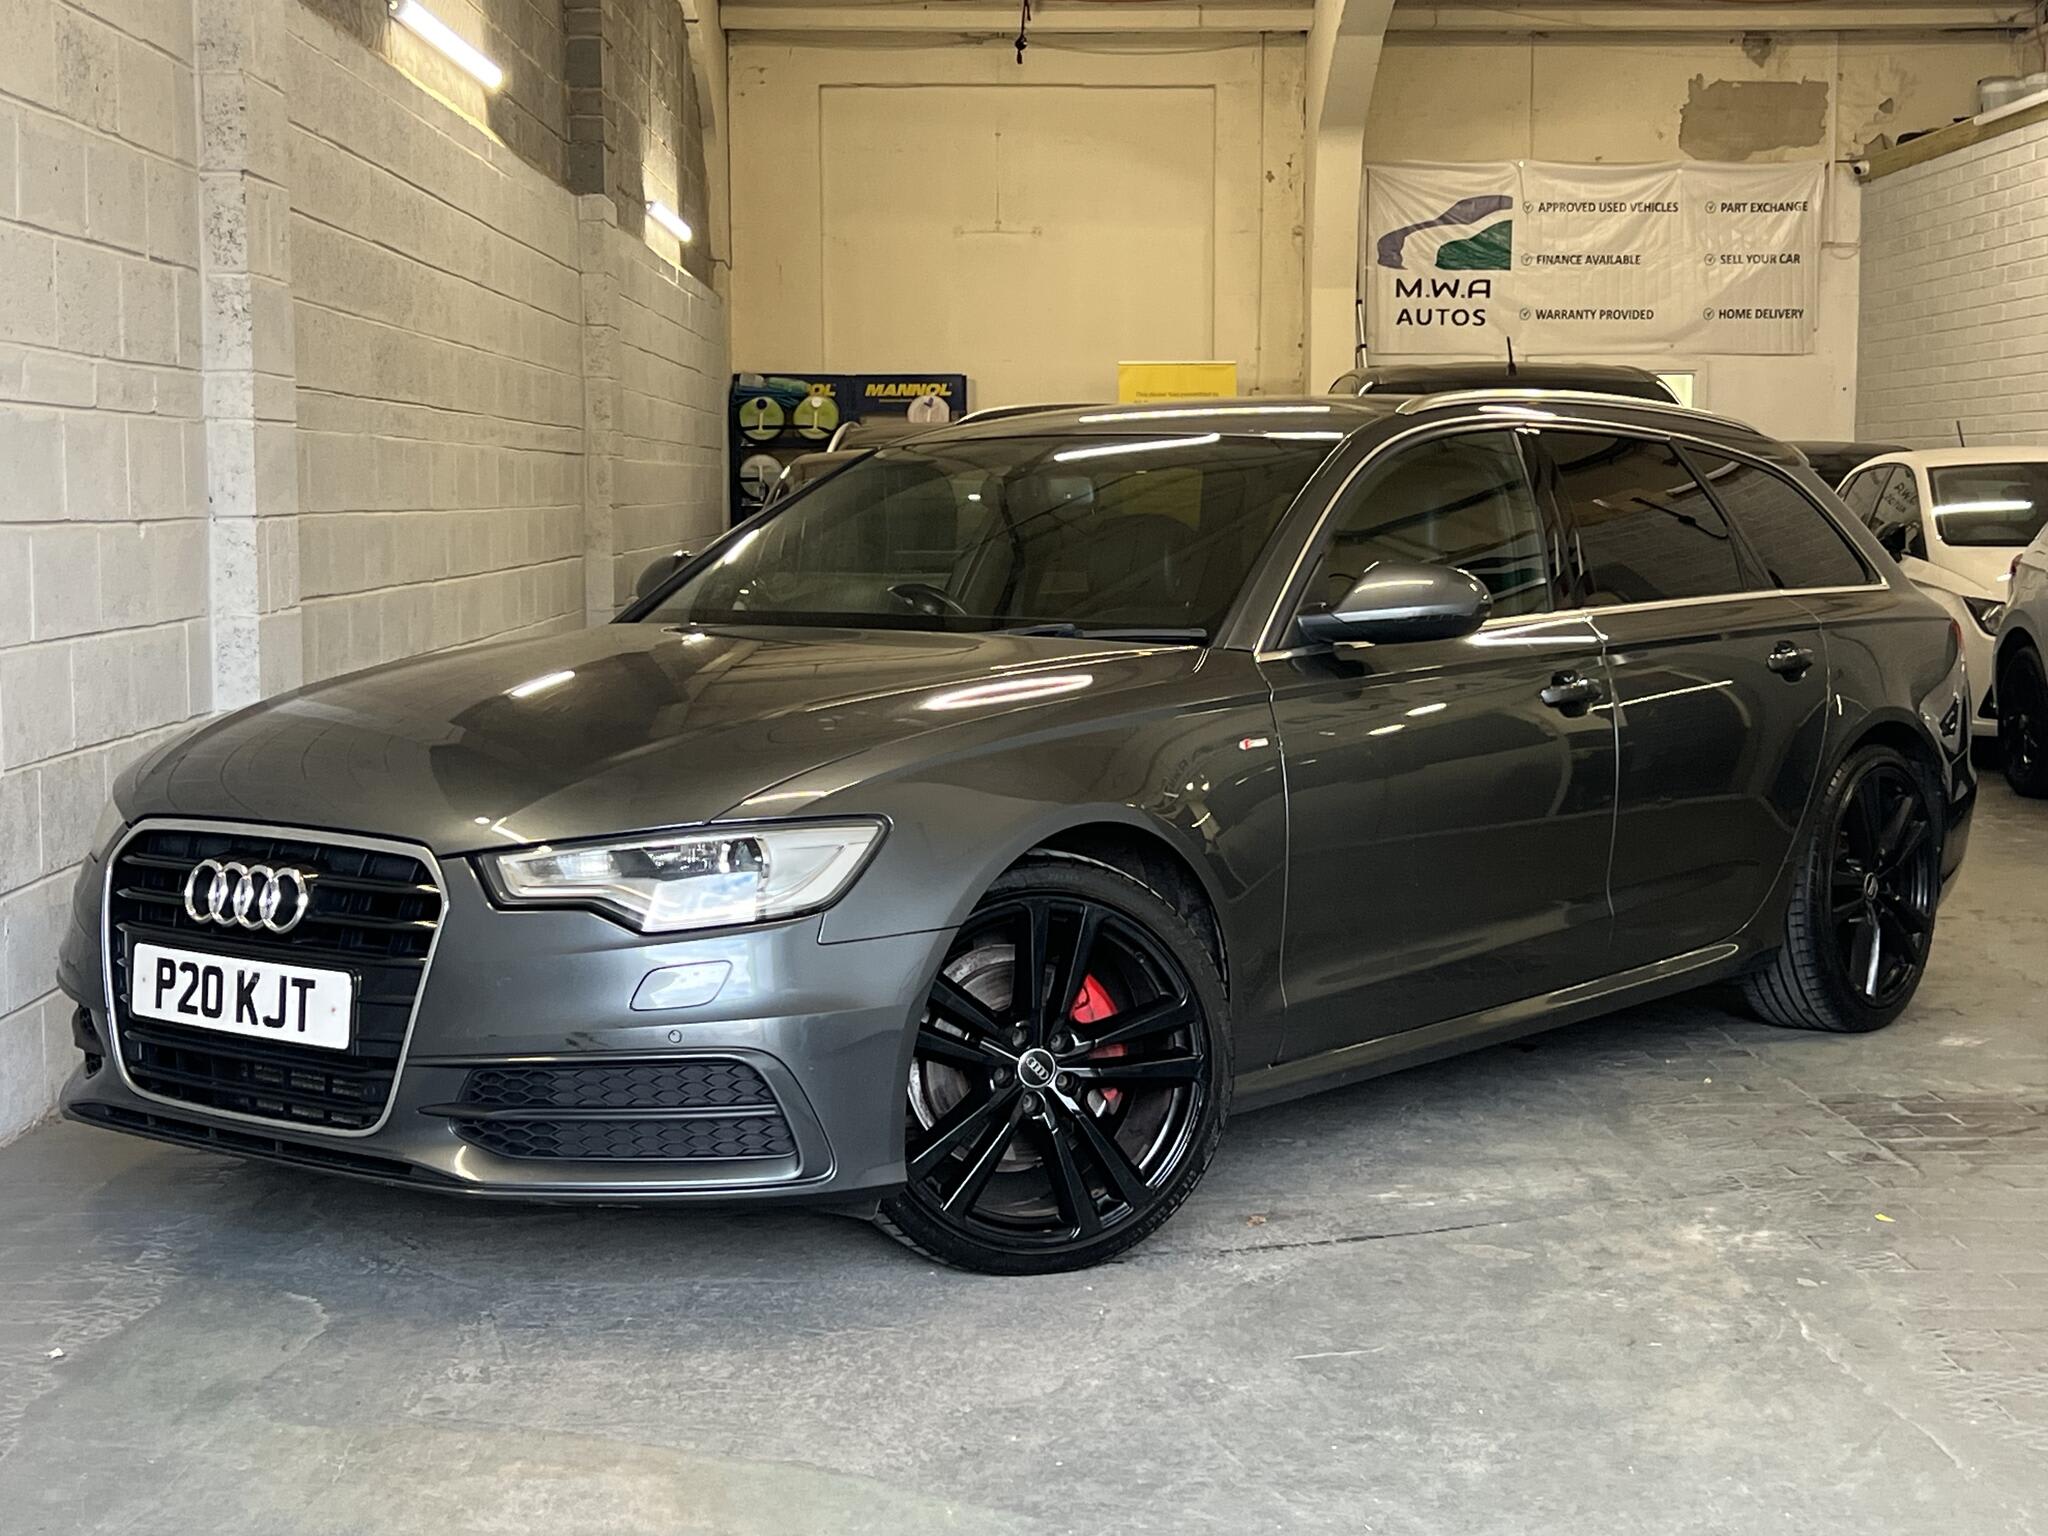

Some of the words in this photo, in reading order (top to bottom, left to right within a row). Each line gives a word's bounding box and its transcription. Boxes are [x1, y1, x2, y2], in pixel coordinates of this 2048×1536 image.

[1538, 202, 1596, 213] APPROVED
[1599, 202, 1627, 213] USED
[1630, 201, 1679, 213] VEHICLES
[1720, 202, 1748, 213] PART
[1750, 201, 1808, 213] EXCHANGE
[1536, 254, 1582, 265] FINANCE
[1584, 254, 1641, 265] AVAILABLE
[1720, 254, 1744, 264] SELL
[1746, 254, 1777, 264] YOUR
[1779, 253, 1800, 264] CAR
[1395, 277, 1491, 299] M.W.A
[1396, 307, 1487, 327] AUTOS
[1535, 308, 1597, 320] WARRANTY
[1599, 308, 1654, 320] PROVIDED
[1718, 308, 1752, 319] HOME
[1755, 308, 1804, 319] DELIVERY
[865, 383, 952, 397] MANNOL
[154, 957, 224, 1019] P20
[235, 969, 316, 1032] KJT
